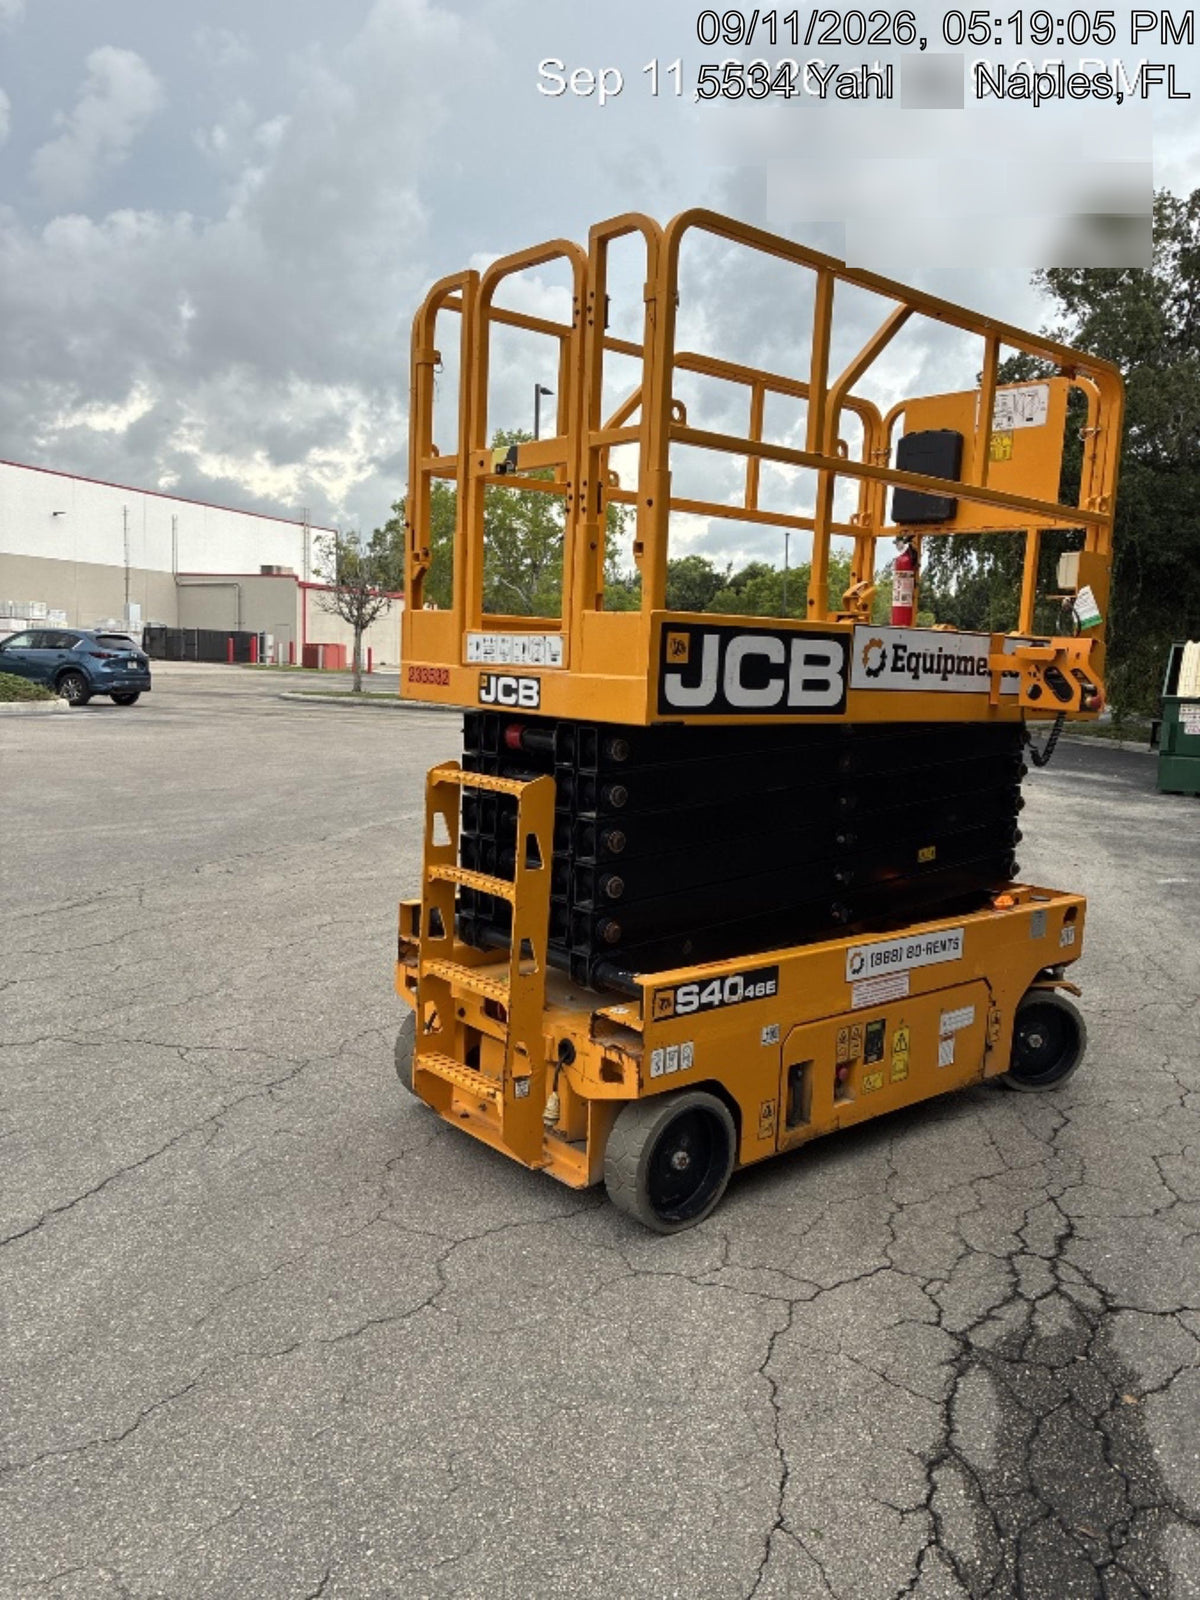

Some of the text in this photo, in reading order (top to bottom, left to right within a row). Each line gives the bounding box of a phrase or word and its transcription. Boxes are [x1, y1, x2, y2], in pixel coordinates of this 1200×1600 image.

[664, 634, 844, 707] JCB
[891, 645, 1025, 681] Equipme
[480, 676, 539, 707] JCB
